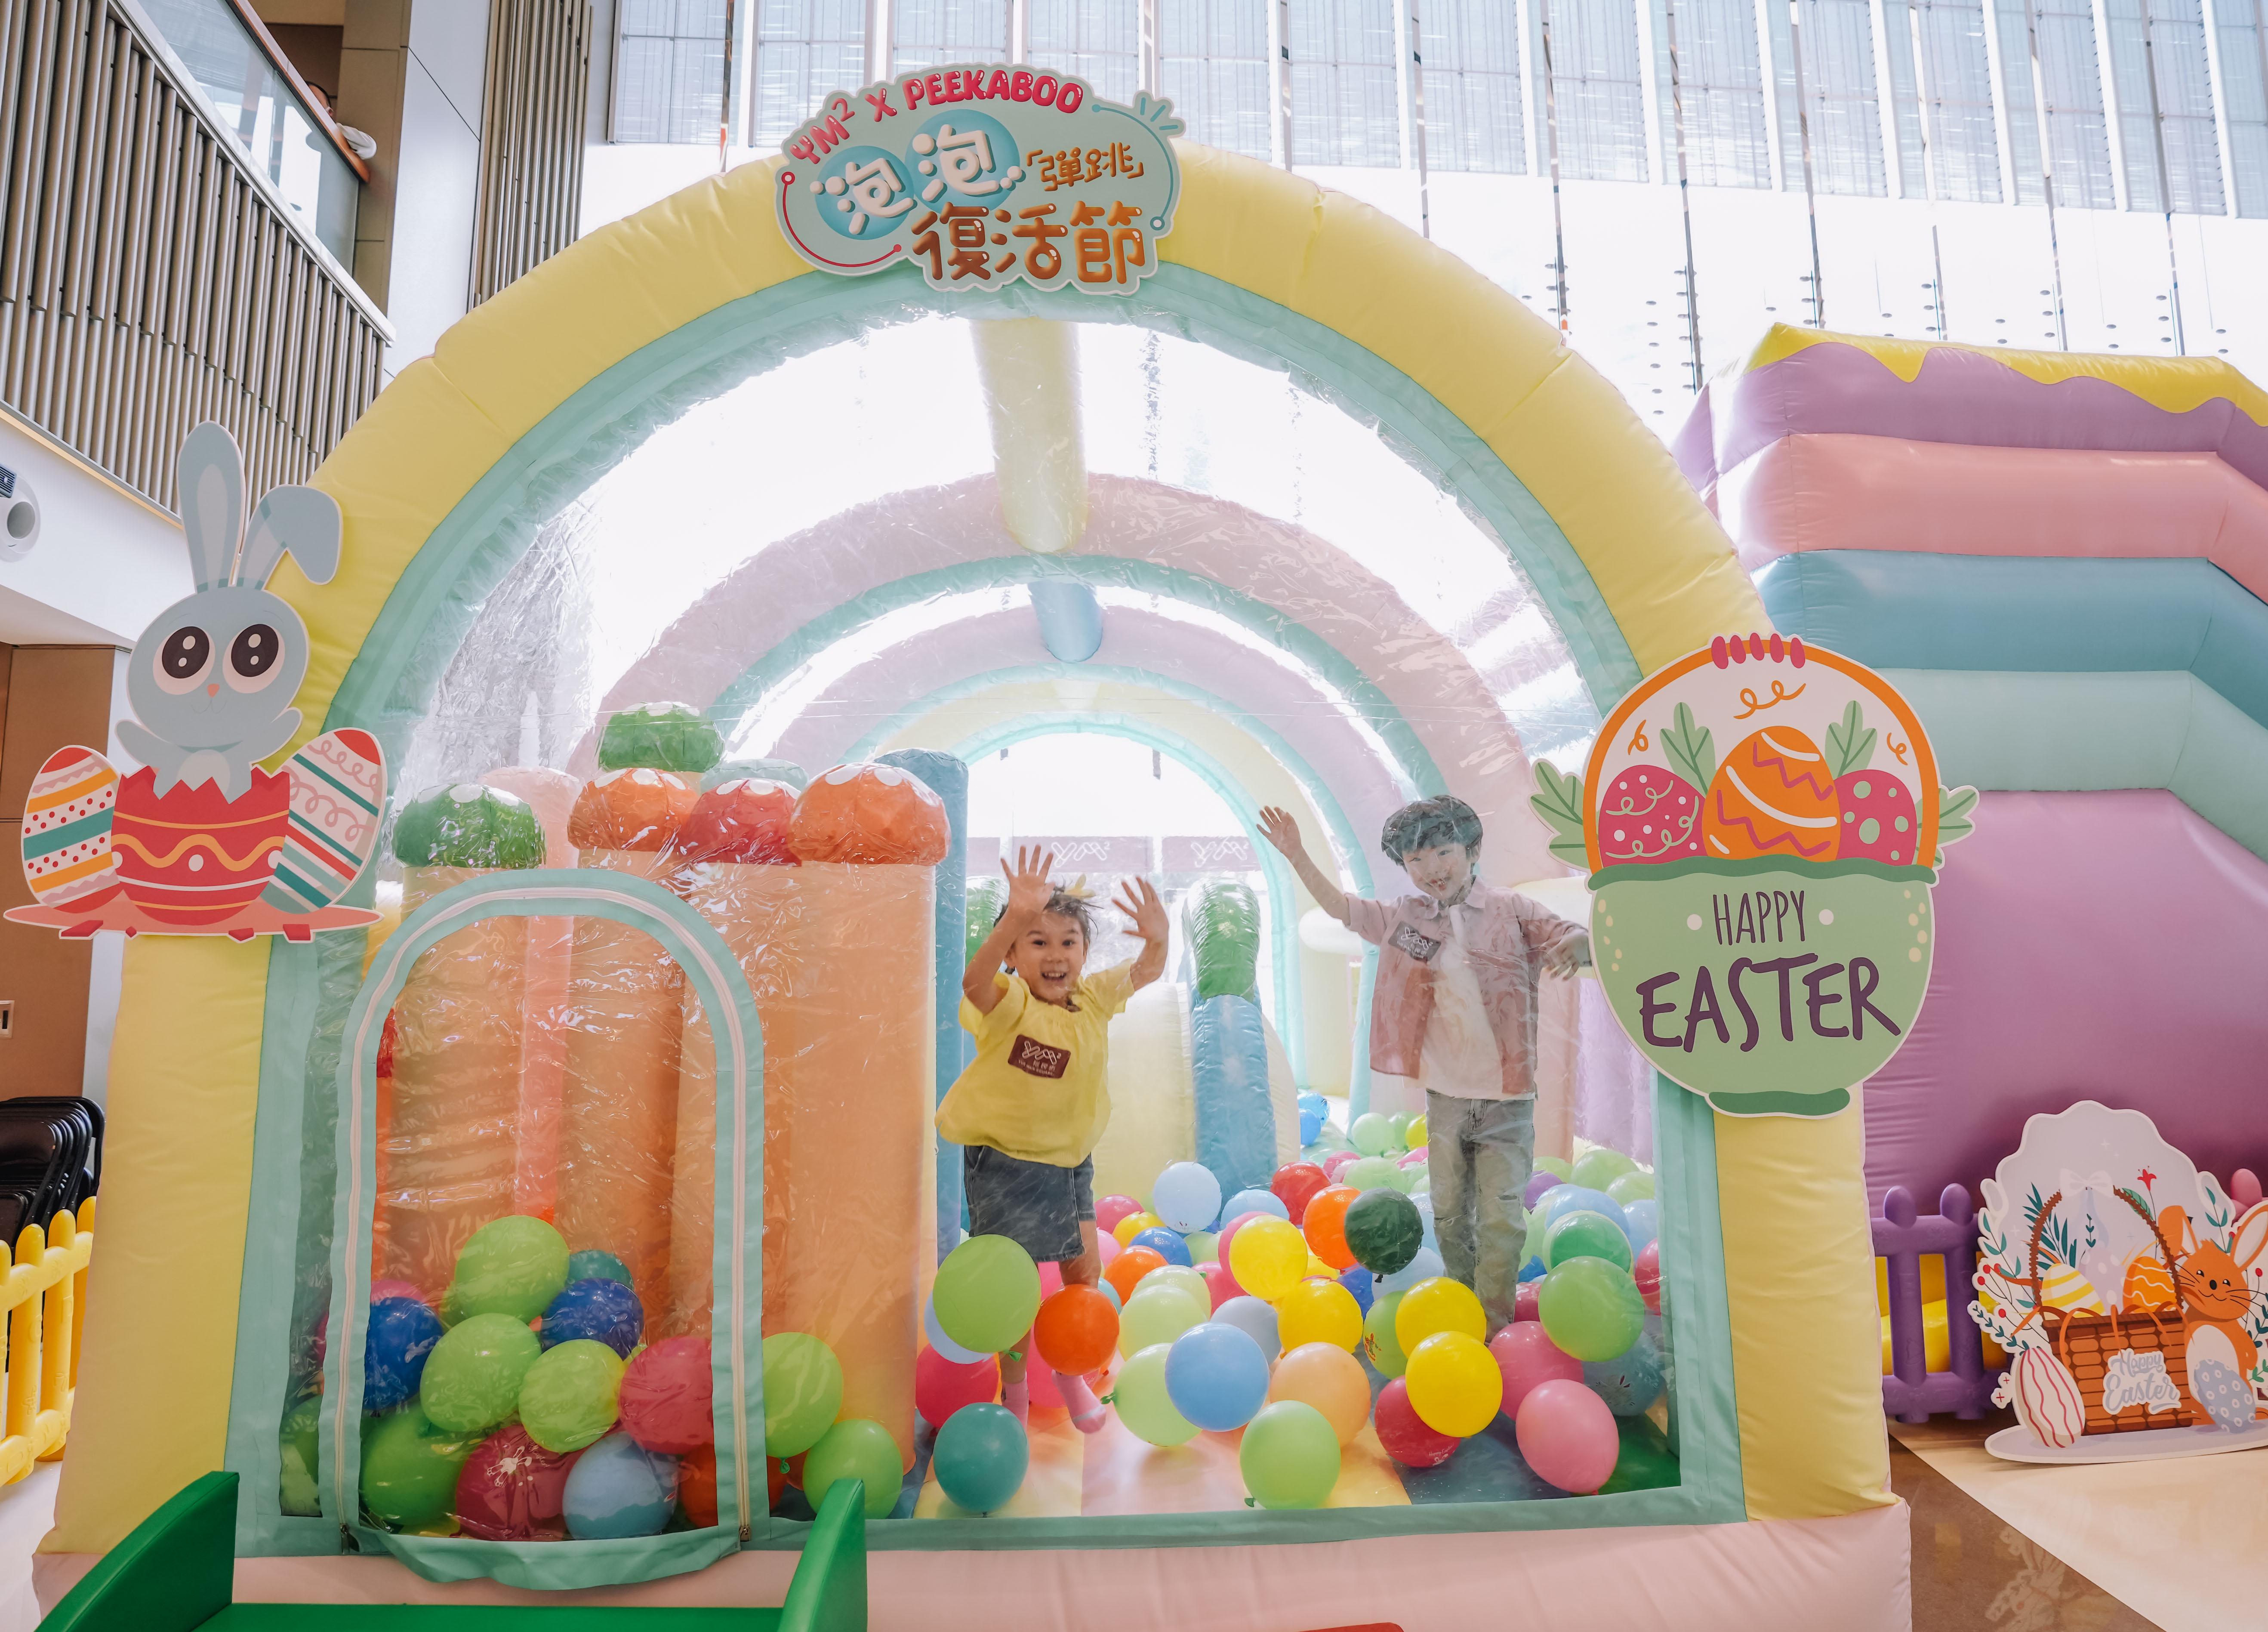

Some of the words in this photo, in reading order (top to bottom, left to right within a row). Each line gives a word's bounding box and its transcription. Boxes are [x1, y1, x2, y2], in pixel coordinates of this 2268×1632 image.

[864, 87, 897, 122] X
[901, 69, 1084, 114] PEEKABOO
[911, 201, 1146, 284] 復活節
[1712, 890, 1805, 946] HAPPY
[1636, 953, 1901, 1053] EASTER
[2111, 1351, 2163, 1377] Happy
[2105, 1373, 2178, 1411] Easter
